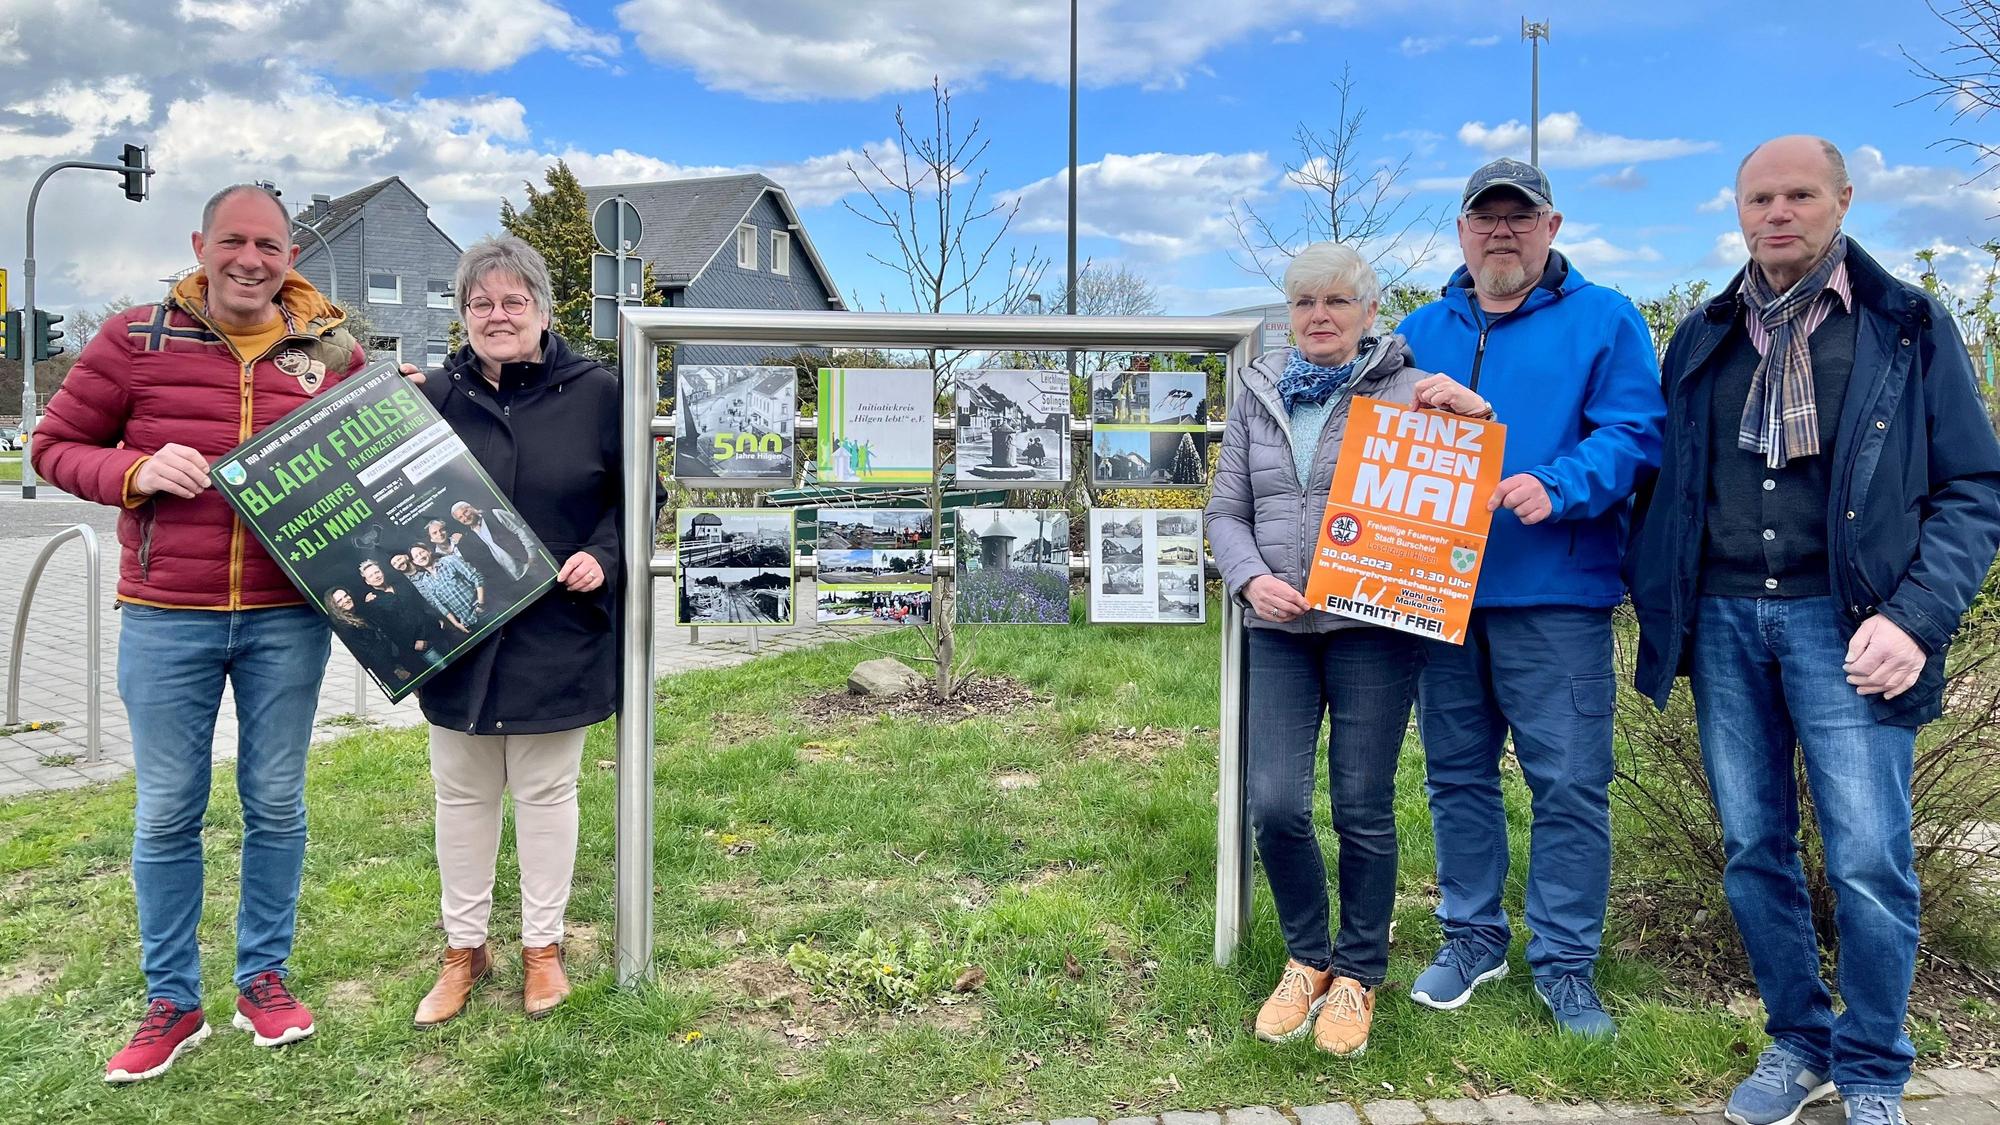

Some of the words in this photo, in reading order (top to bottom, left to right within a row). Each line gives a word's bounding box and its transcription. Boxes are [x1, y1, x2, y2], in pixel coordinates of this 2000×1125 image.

[858, 403, 915, 412] Initiativkreis
[1041, 393, 1069, 407] Solingen
[1373, 404, 1485, 453] TANZ
[238, 442, 334, 517] BLÄCK
[326, 388, 420, 458] FÖÖSS
[259, 439, 282, 457] JAHRE
[713, 431, 783, 461] 500
[735, 452, 756, 461] Jahre
[757, 452, 782, 461] Hilgen
[1362, 436, 1399, 464] IN
[1407, 444, 1480, 481] DEN
[347, 456, 361, 471] IN
[1351, 462, 1475, 527] MAI
[323, 498, 373, 540] MIMO
[1367, 520, 1406, 537] Freiwillige
[1407, 529, 1449, 545] Feuerwehr
[1375, 533, 1395, 544] Stadt
[1396, 537, 1436, 553] Burscheid
[1320, 547, 1393, 571] 30.04.2023
[1409, 567, 1445, 583] 19.30
[1447, 576, 1472, 589] Uhr
[1401, 588, 1424, 599] Wahl
[1426, 595, 1443, 604] der
[1438, 586, 1469, 601] Hilgen
[1326, 595, 1401, 623] EINTRITT
[1405, 614, 1443, 634] FREI
